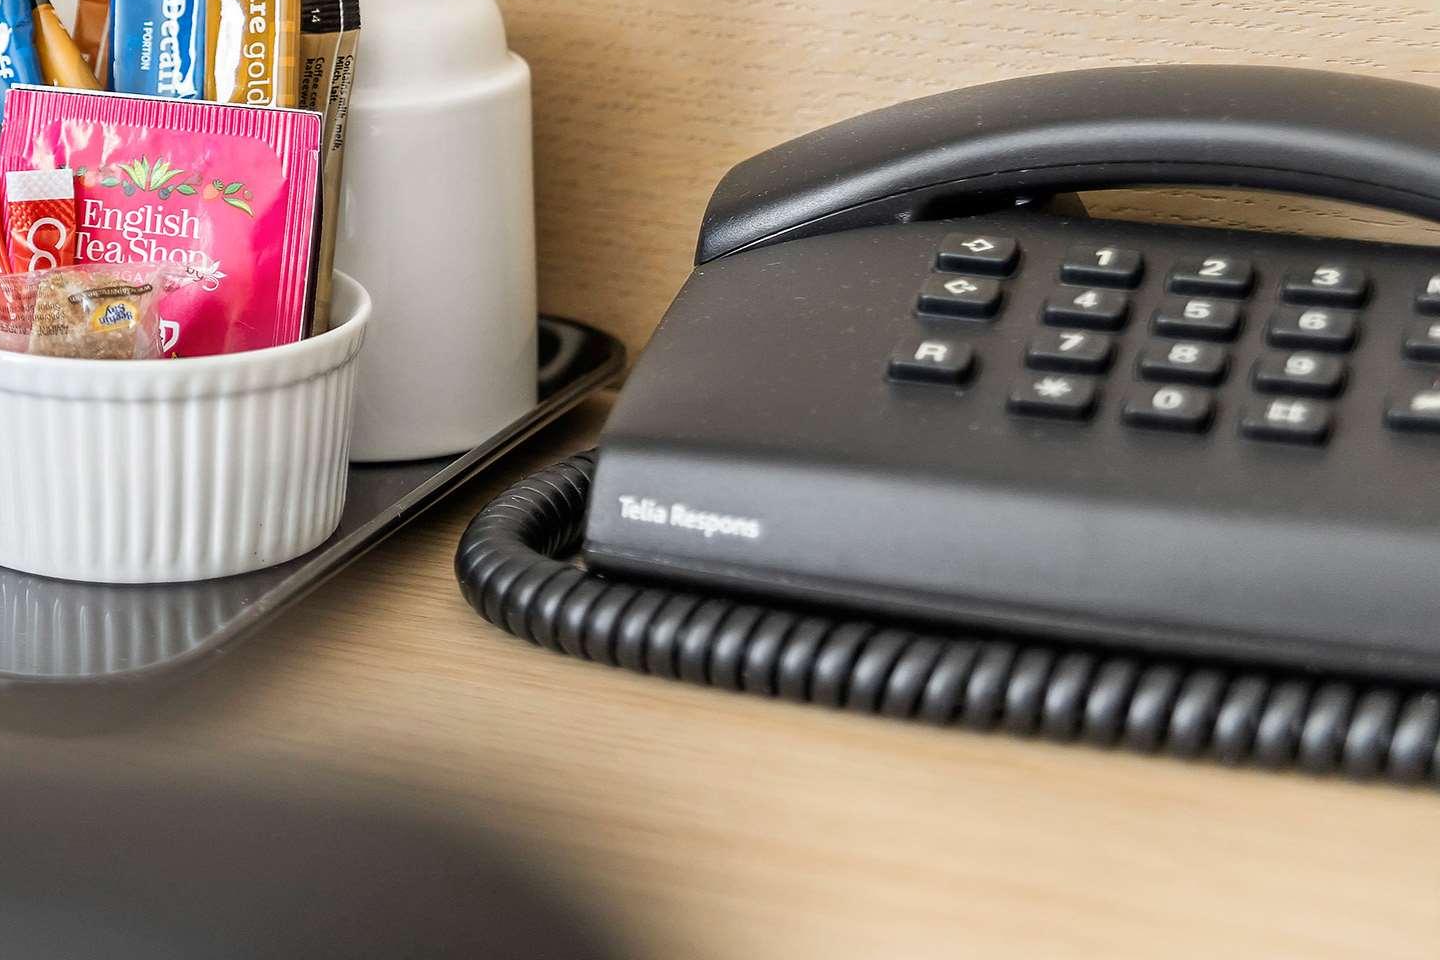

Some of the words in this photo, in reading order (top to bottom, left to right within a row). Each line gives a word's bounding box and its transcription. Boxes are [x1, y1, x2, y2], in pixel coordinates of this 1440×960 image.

[311, 7, 321, 23] 14
[140, 27, 154, 71] PORTION
[242, 42, 270, 106] gold
[311, 57, 325, 91] Coffee
[82, 199, 201, 240] English
[73, 232, 125, 264] Tea
[128, 239, 214, 276] Shop
[1096, 250, 1112, 265] 1
[1198, 259, 1227, 276] 2
[1312, 268, 1341, 285] 3
[1074, 291, 1098, 308] 4
[1183, 300, 1211, 319] 5
[1298, 312, 1328, 330] 6
[915, 342, 947, 362] R
[1060, 334, 1085, 351] 7
[1168, 344, 1199, 363] 8
[1285, 357, 1315, 375] 9
[1152, 389, 1183, 410] 0
[619, 494, 666, 524] Telia
[670, 503, 760, 538] Respons
